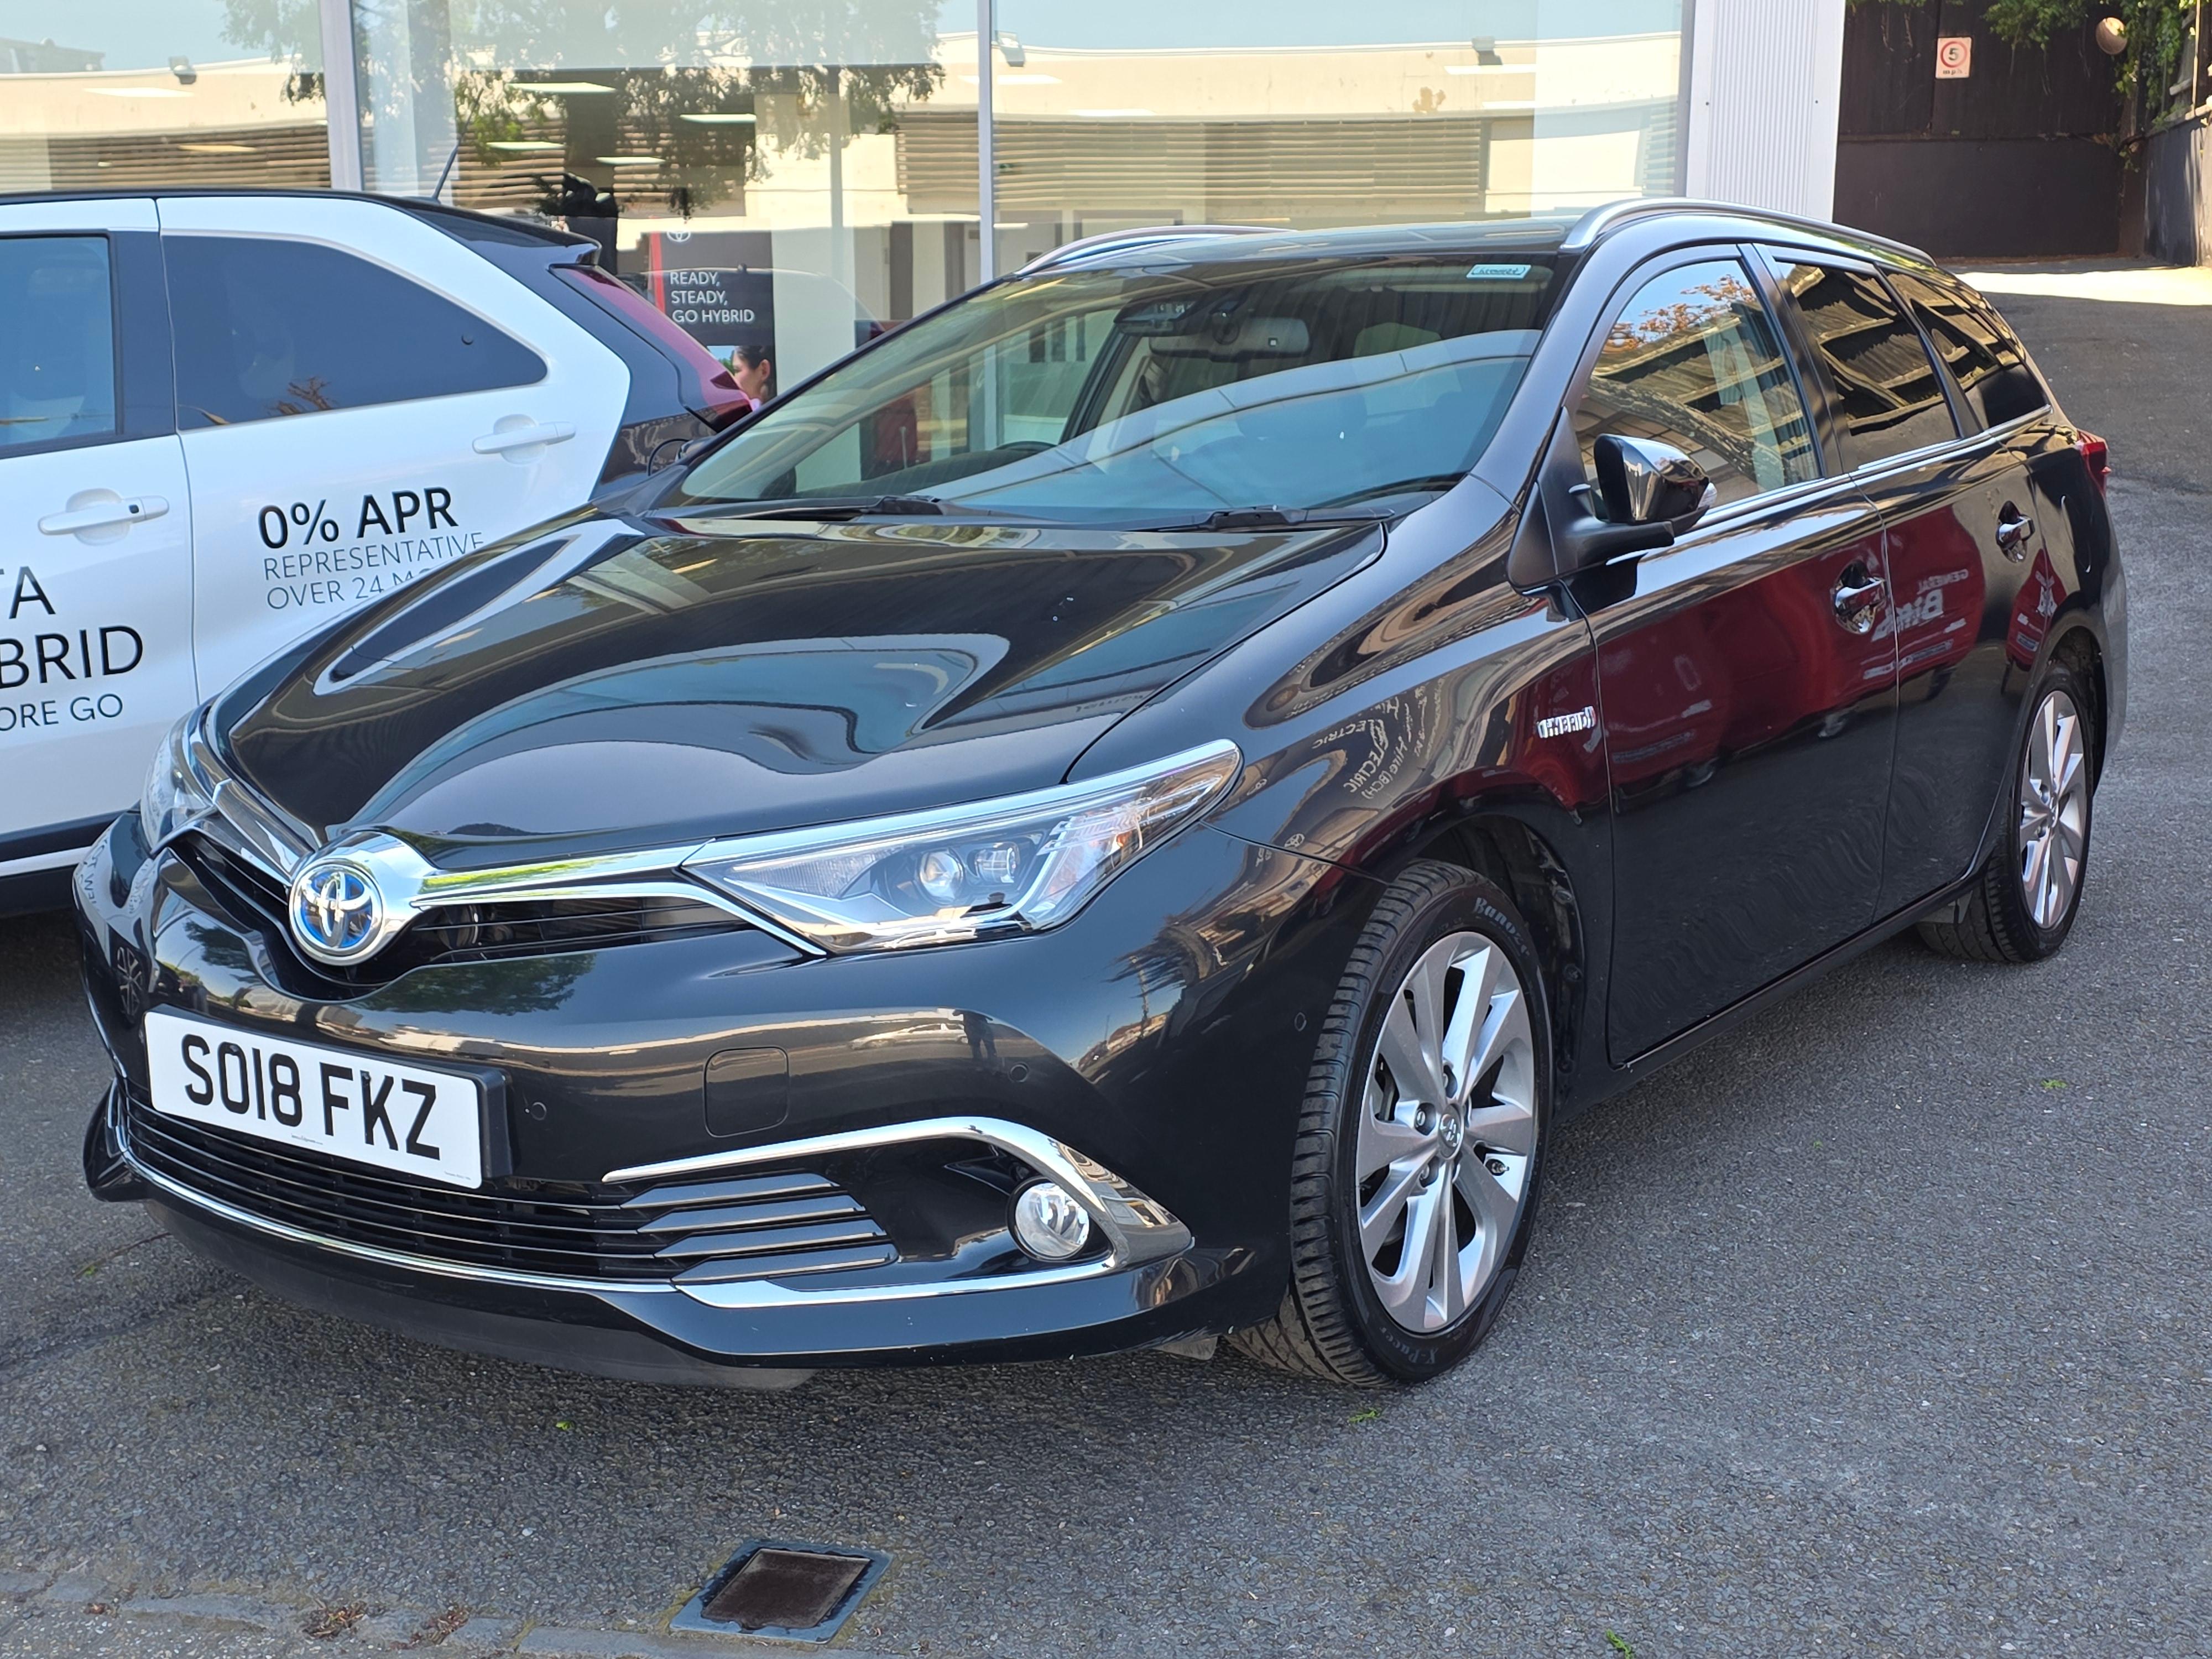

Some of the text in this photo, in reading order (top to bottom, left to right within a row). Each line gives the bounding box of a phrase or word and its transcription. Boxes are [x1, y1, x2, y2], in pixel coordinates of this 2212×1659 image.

[1948, 48, 1959, 61] 5
[670, 271, 721, 286] READY,
[671, 290, 728, 305] STEADY,
[672, 309, 755, 323] GO HYBRID
[258, 487, 459, 549] 0% APR
[264, 531, 484, 581] REPRESENTATIVE
[0, 566, 56, 619] A
[267, 580, 345, 610] OVER
[352, 574, 384, 599] 24
[70, 693, 123, 722] GO
[181, 1034, 441, 1161] SO18 FKZ
